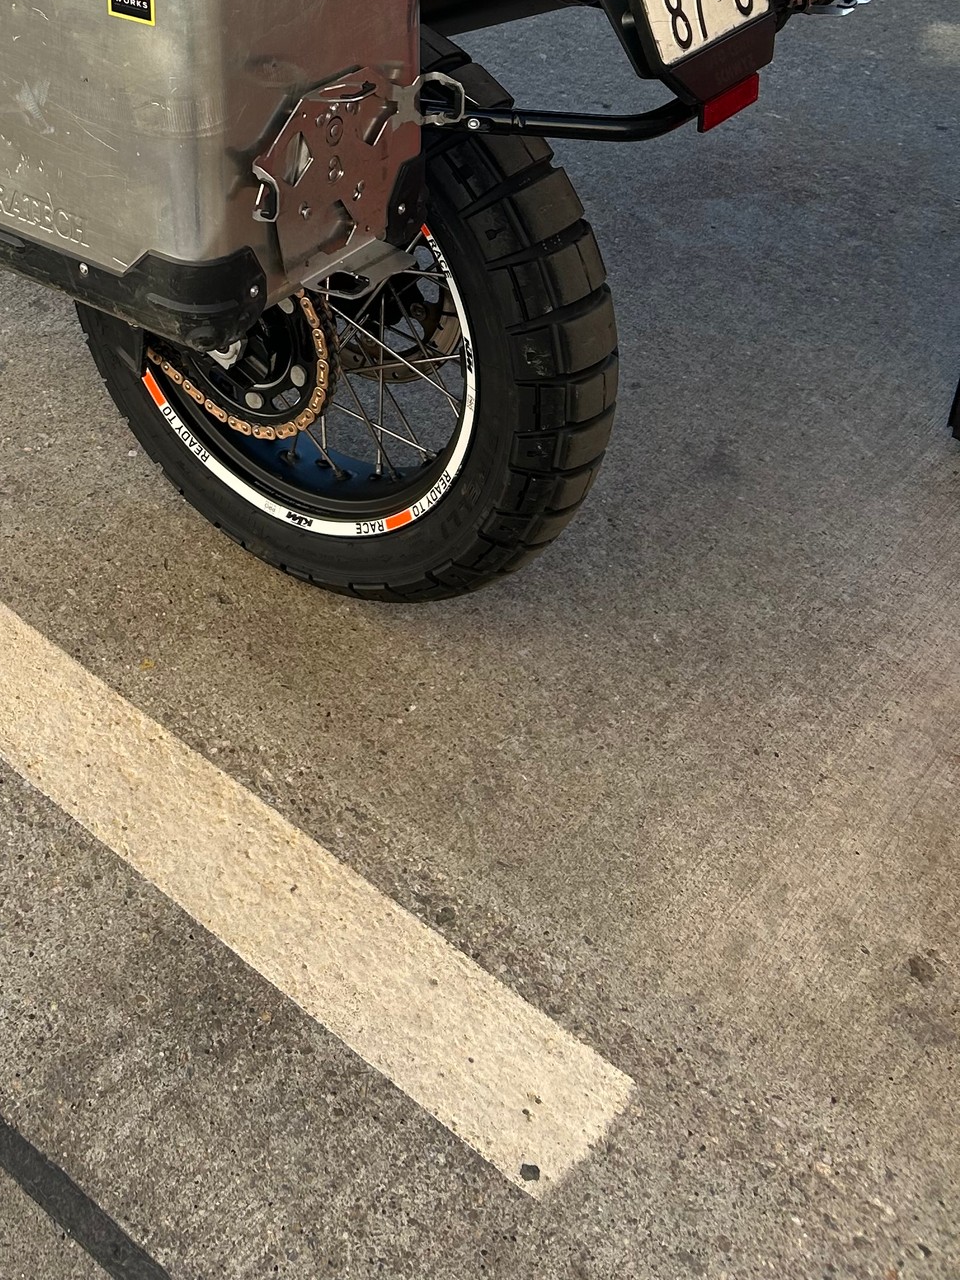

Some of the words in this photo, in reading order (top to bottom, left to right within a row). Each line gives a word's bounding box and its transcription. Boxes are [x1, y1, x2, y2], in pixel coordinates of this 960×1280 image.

[162, 405, 177, 424] TO
[175, 427, 210, 463] READY
[426, 470, 452, 505] READY
[412, 501, 426, 518] TO
[286, 511, 314, 527] KTM
[356, 520, 385, 535] RACE
